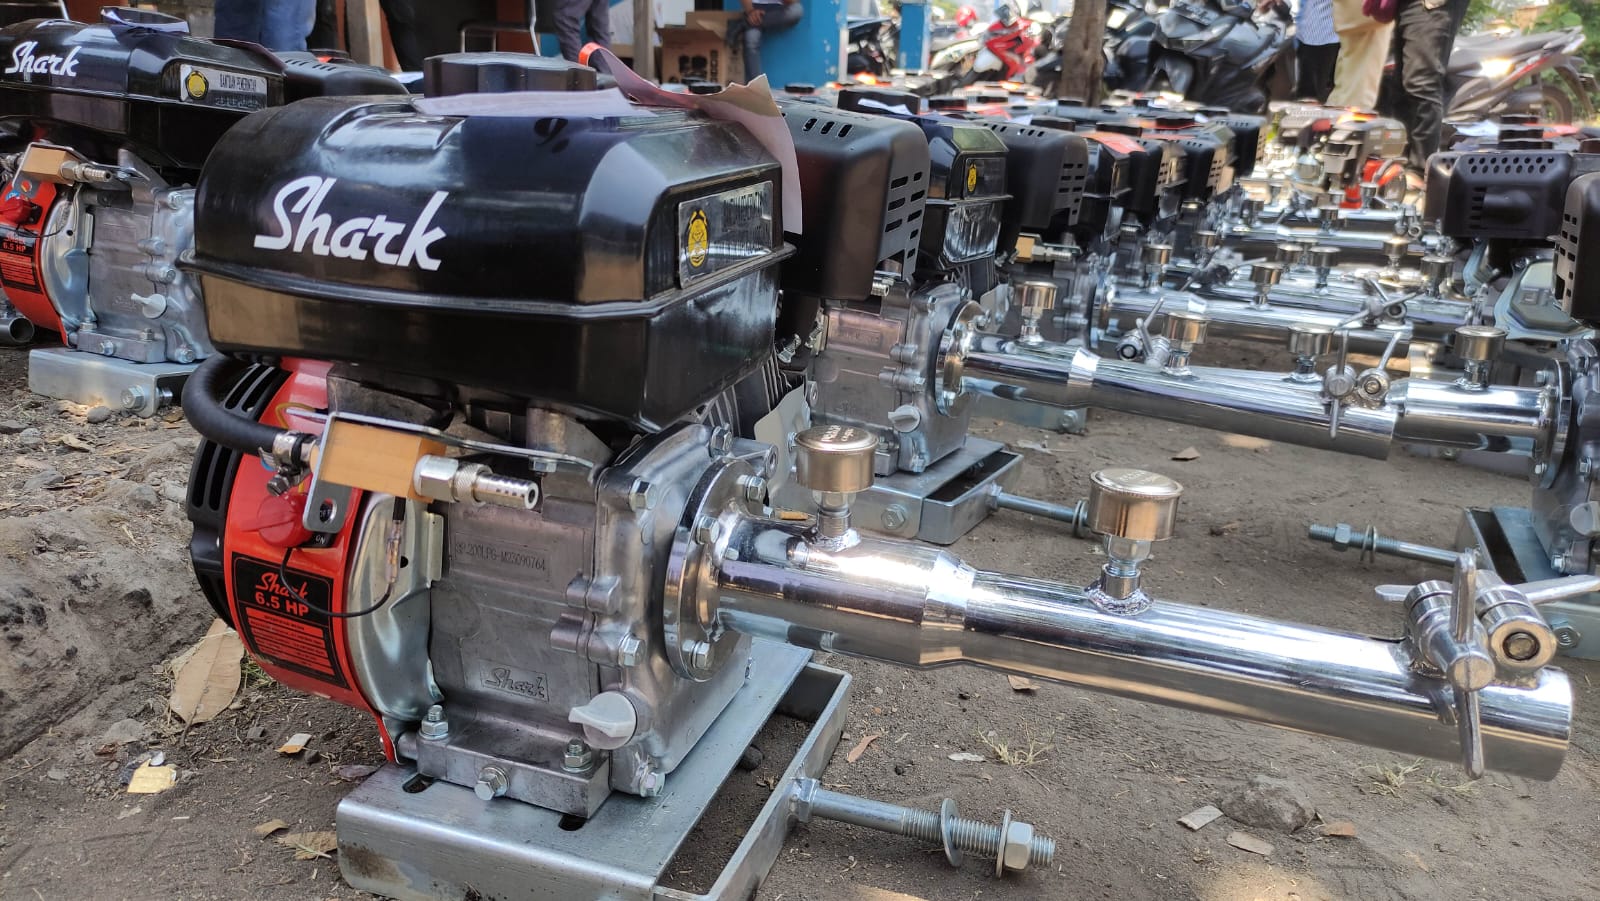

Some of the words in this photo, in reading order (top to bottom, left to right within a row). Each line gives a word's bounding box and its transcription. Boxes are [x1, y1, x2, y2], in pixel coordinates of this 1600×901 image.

[5, 41, 82, 77] Shark
[253, 175, 449, 271] Shark
[315, 534, 326, 545] ON
[255, 591, 281, 609] 6.5
[285, 600, 309, 617] HP
[485, 667, 545, 698] Shark
